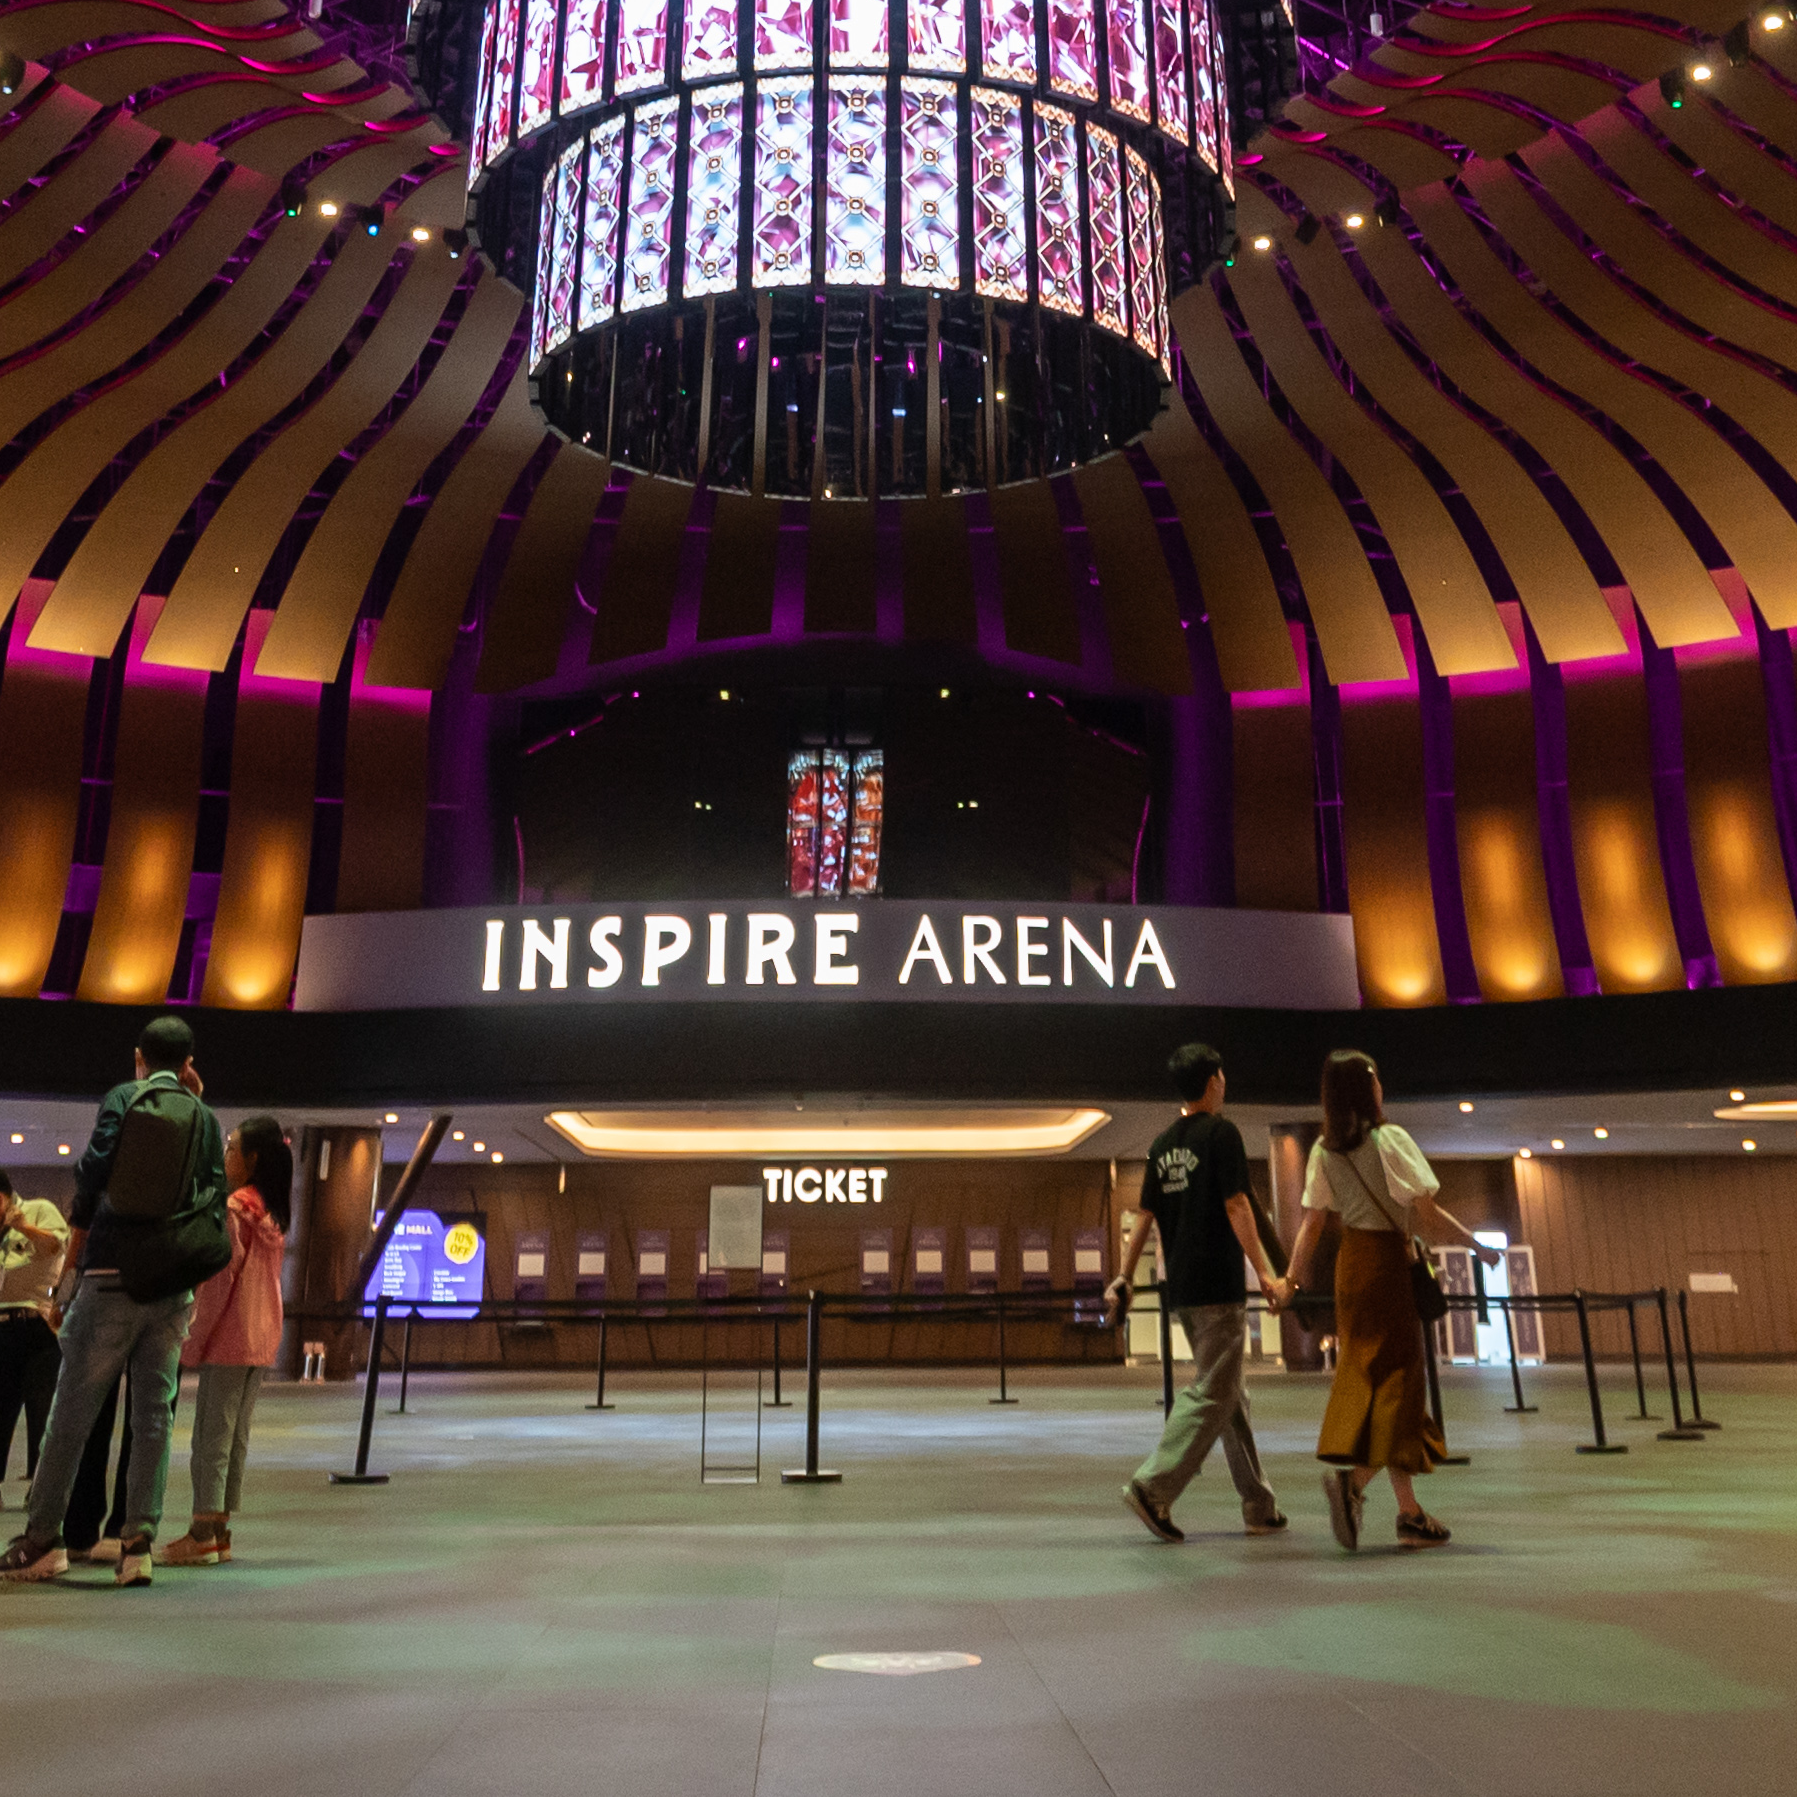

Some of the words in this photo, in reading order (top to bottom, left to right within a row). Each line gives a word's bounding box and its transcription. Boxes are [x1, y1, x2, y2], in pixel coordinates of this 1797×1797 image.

[482, 913, 859, 991] INSPIRE
[899, 914, 1175, 988] ARENA
[763, 1167, 888, 1203] TICKET
[406, 1225, 432, 1234] MALL
[454, 1231, 474, 1246] 10%
[449, 1244, 471, 1258] OFF
